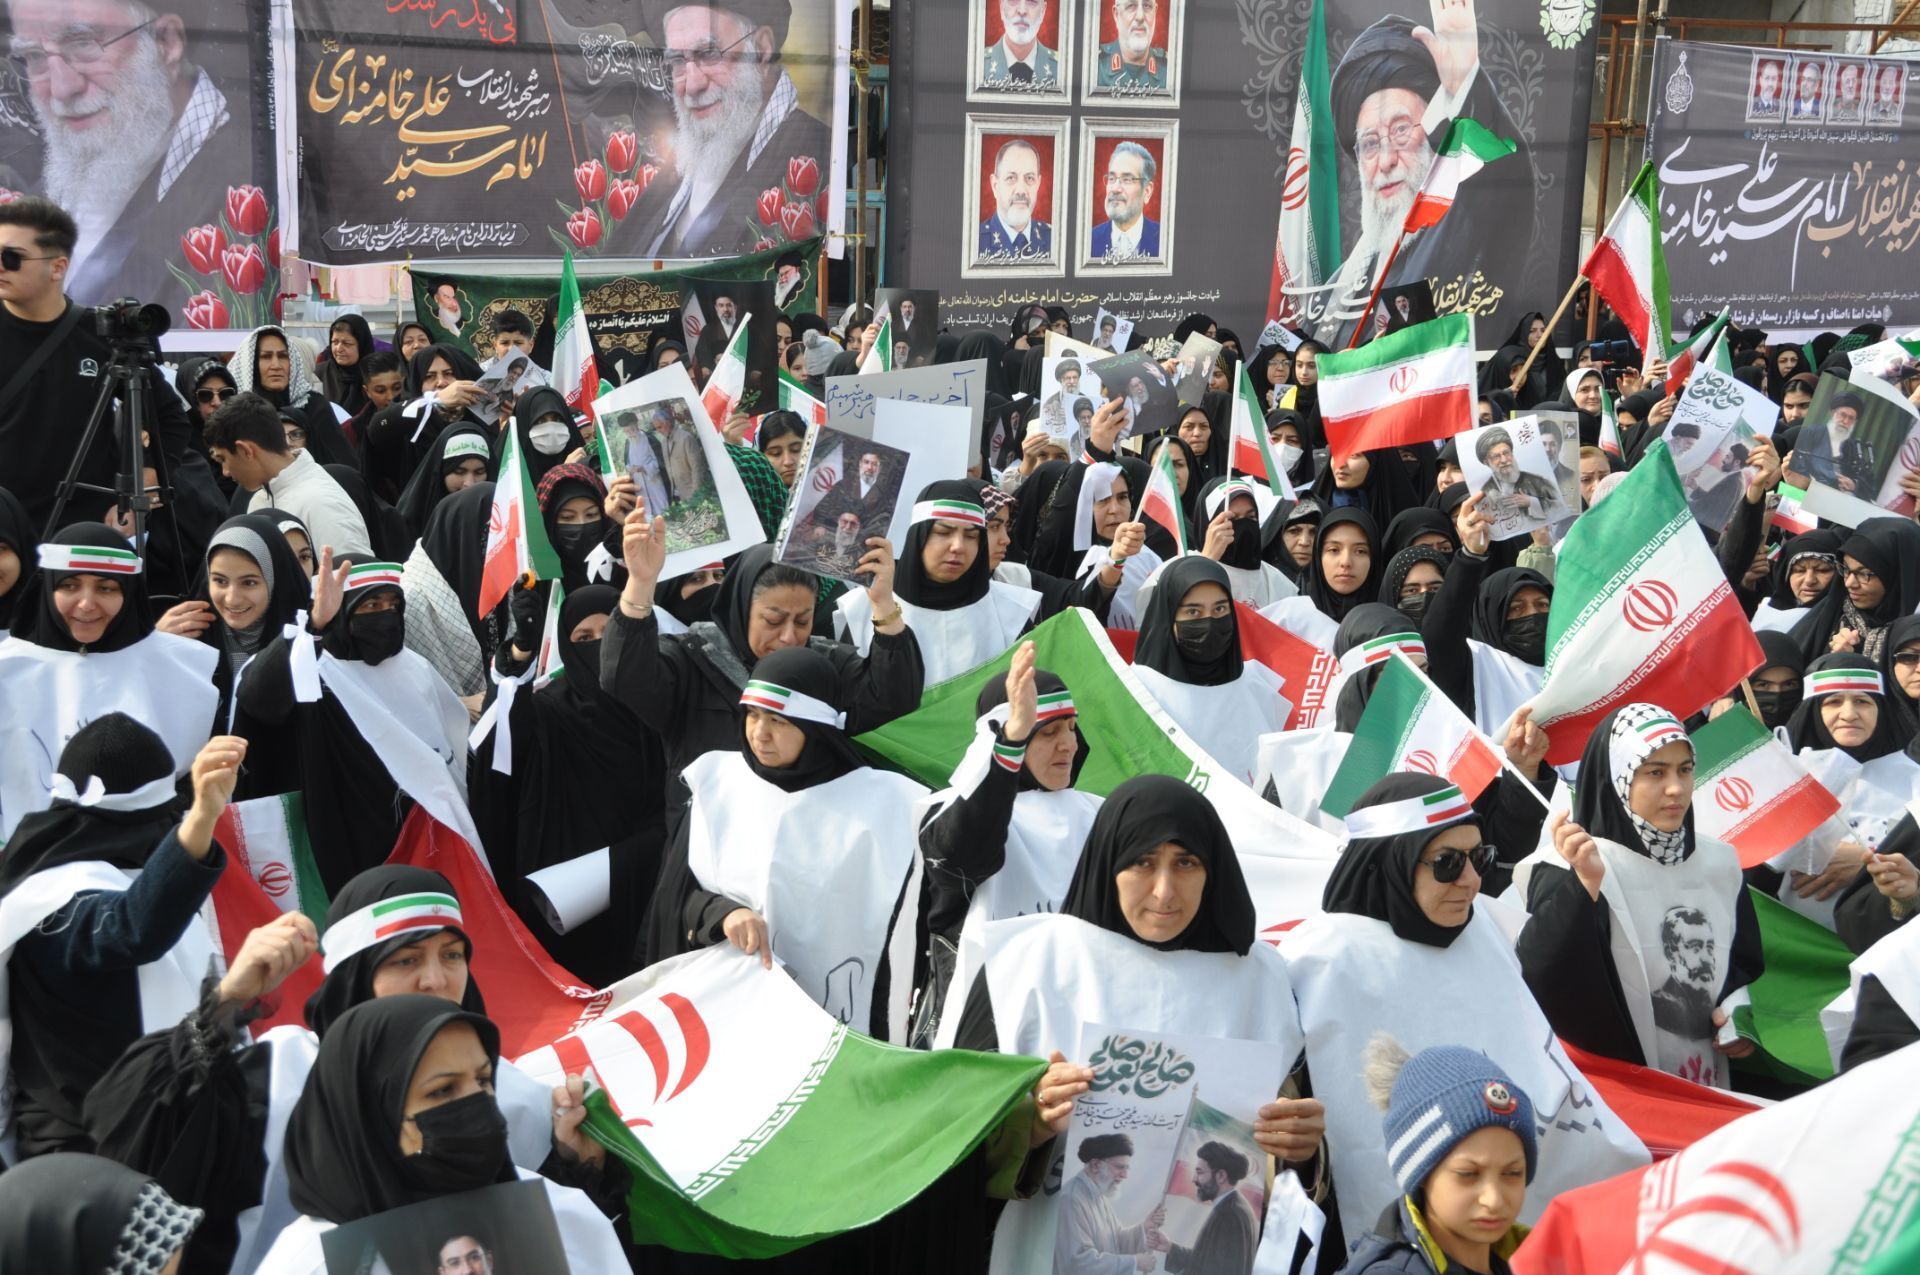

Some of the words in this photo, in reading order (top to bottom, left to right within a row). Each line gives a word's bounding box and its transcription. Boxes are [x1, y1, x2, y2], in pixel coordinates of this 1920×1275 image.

[488, 7, 517, 46] بی
[457, 65, 512, 105] انقلاب
[497, 67, 539, 118] شهید
[398, 73, 512, 145] علی
[383, 138, 518, 202] سید
[486, 130, 548, 192] امام
[1737, 141, 1809, 214] علی
[1698, 180, 1824, 266] سید
[1806, 159, 1911, 259] انقلاب
[1790, 171, 1851, 293] امام
[1039, 288, 1059, 307] امام
[1060, 292, 1099, 308] حضرت
[1099, 291, 1122, 306] اسلامی
[1122, 290, 1144, 305] انقلاب
[1161, 292, 1176, 304] رهبر
[1176, 290, 1198, 304] جانسوز
[1198, 288, 1221, 303] شهادت
[1475, 284, 1505, 316] رهبر
[955, 313, 980, 327] تسلیت
[979, 313, 995, 328] ایران
[1130, 309, 1145, 322] ارشد
[1146, 308, 1177, 322] فرماندهان
[1784, 308, 1801, 325] بازار
[1819, 313, 1825, 324] و
[1687, 386, 1721, 405] بعد
[1712, 382, 1745, 410] صالح
[1088, 1034, 1147, 1069] صالح
[1088, 1059, 1142, 1096] بعد
[1134, 1041, 1196, 1099] صالح
